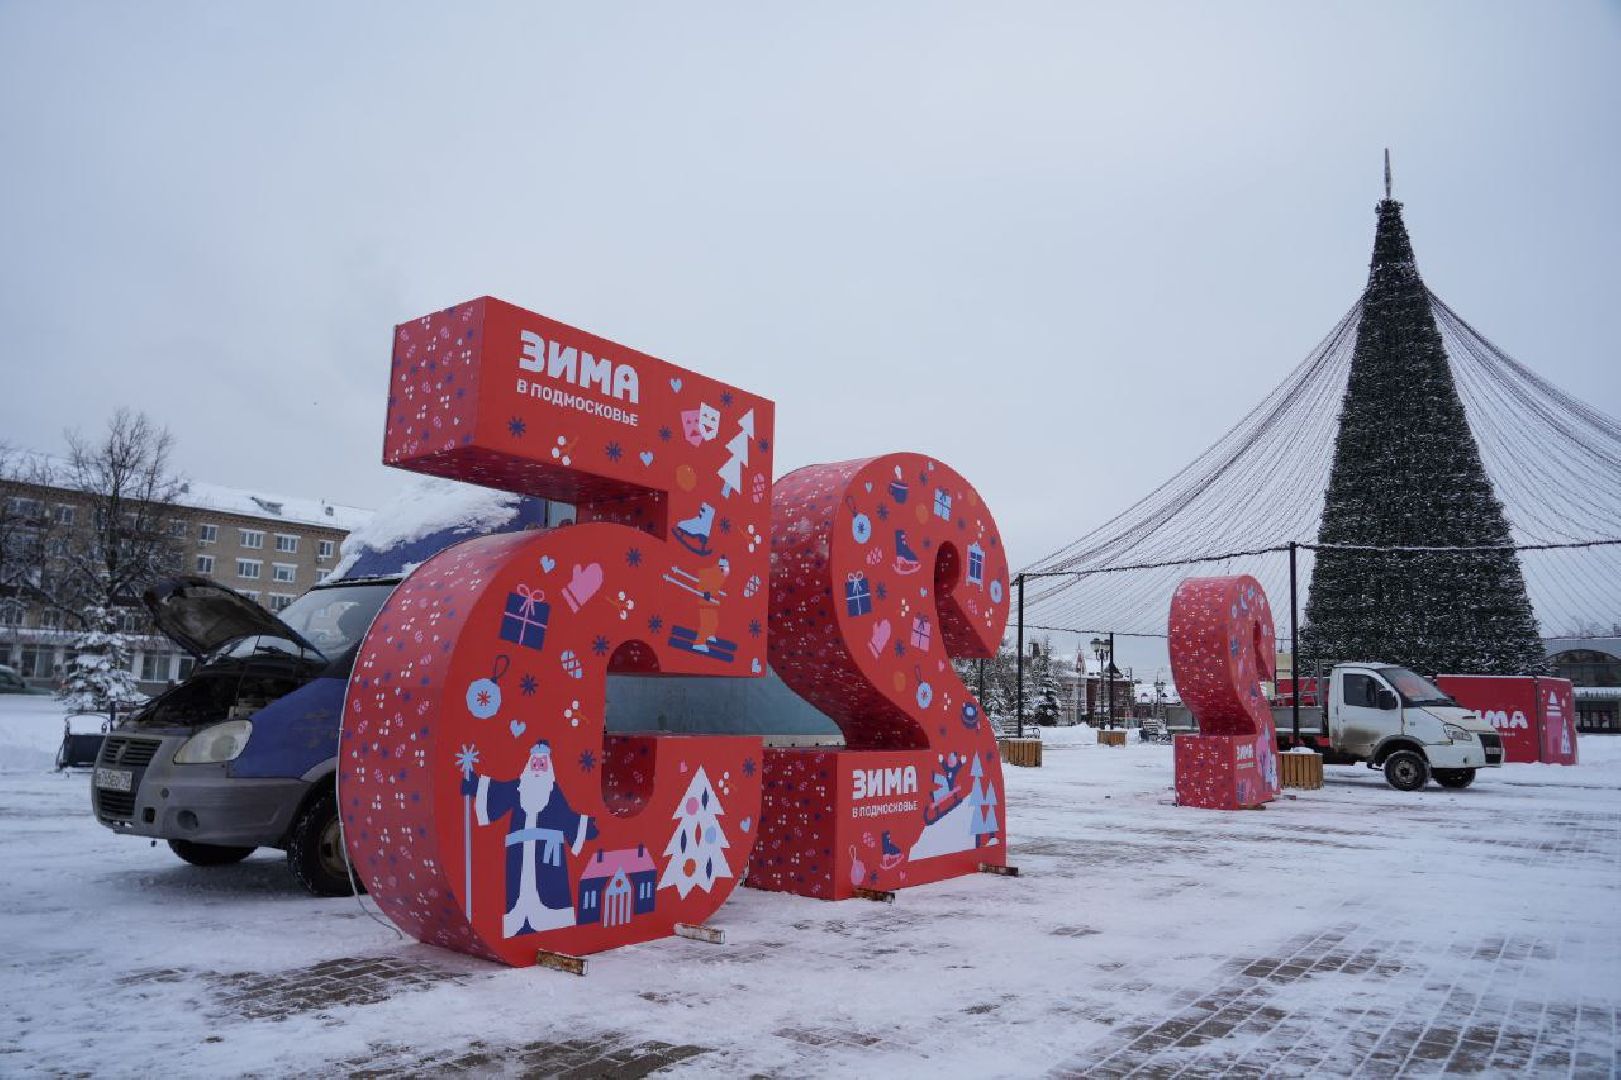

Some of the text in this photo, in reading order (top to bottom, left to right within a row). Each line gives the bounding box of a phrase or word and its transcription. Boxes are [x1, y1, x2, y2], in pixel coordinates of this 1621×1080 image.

[519, 330, 639, 404] ЗИМА
[516, 378, 639, 427] В ПОДМОСКОВЬЕ
[852, 765, 918, 800] ЗИМА
[859, 800, 919, 817] ПОДМОСКОВЬЕ
